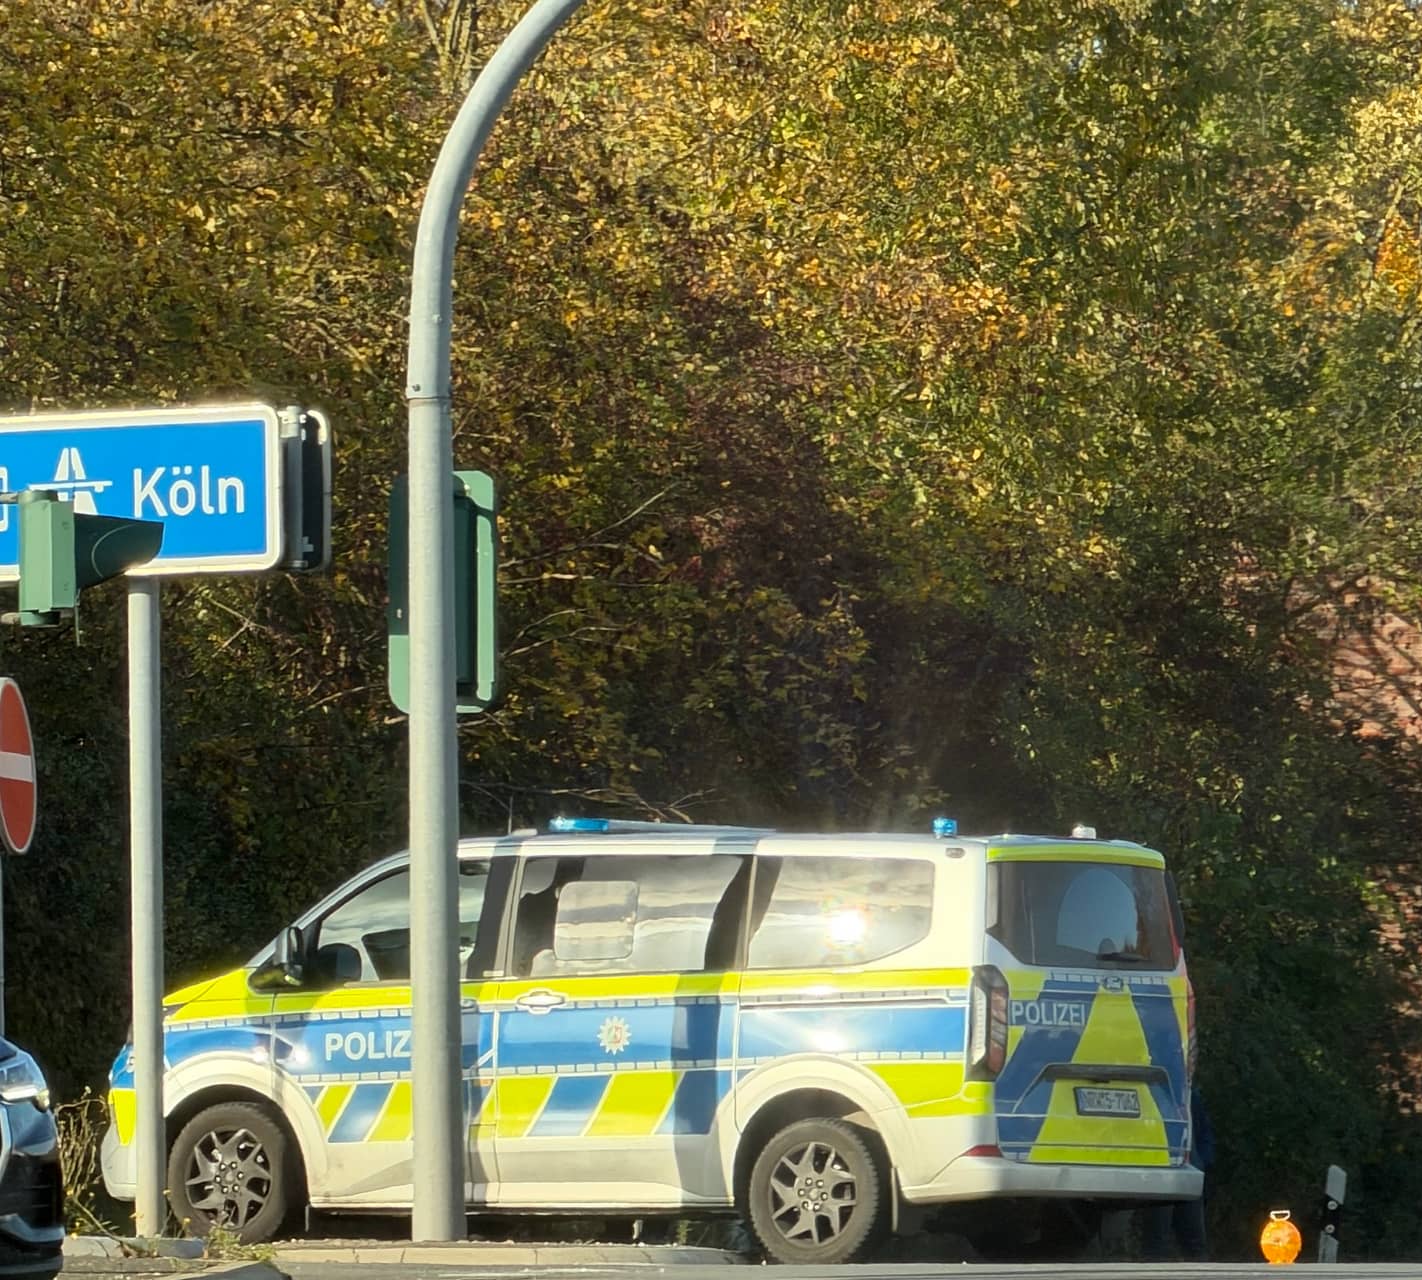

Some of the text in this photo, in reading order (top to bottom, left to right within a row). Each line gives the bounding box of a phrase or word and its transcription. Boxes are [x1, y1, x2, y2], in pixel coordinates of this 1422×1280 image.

[133, 465, 245, 518] Köln
[1011, 1001, 1085, 1025] POLIZEI
[325, 1030, 412, 1061] POLIZ
